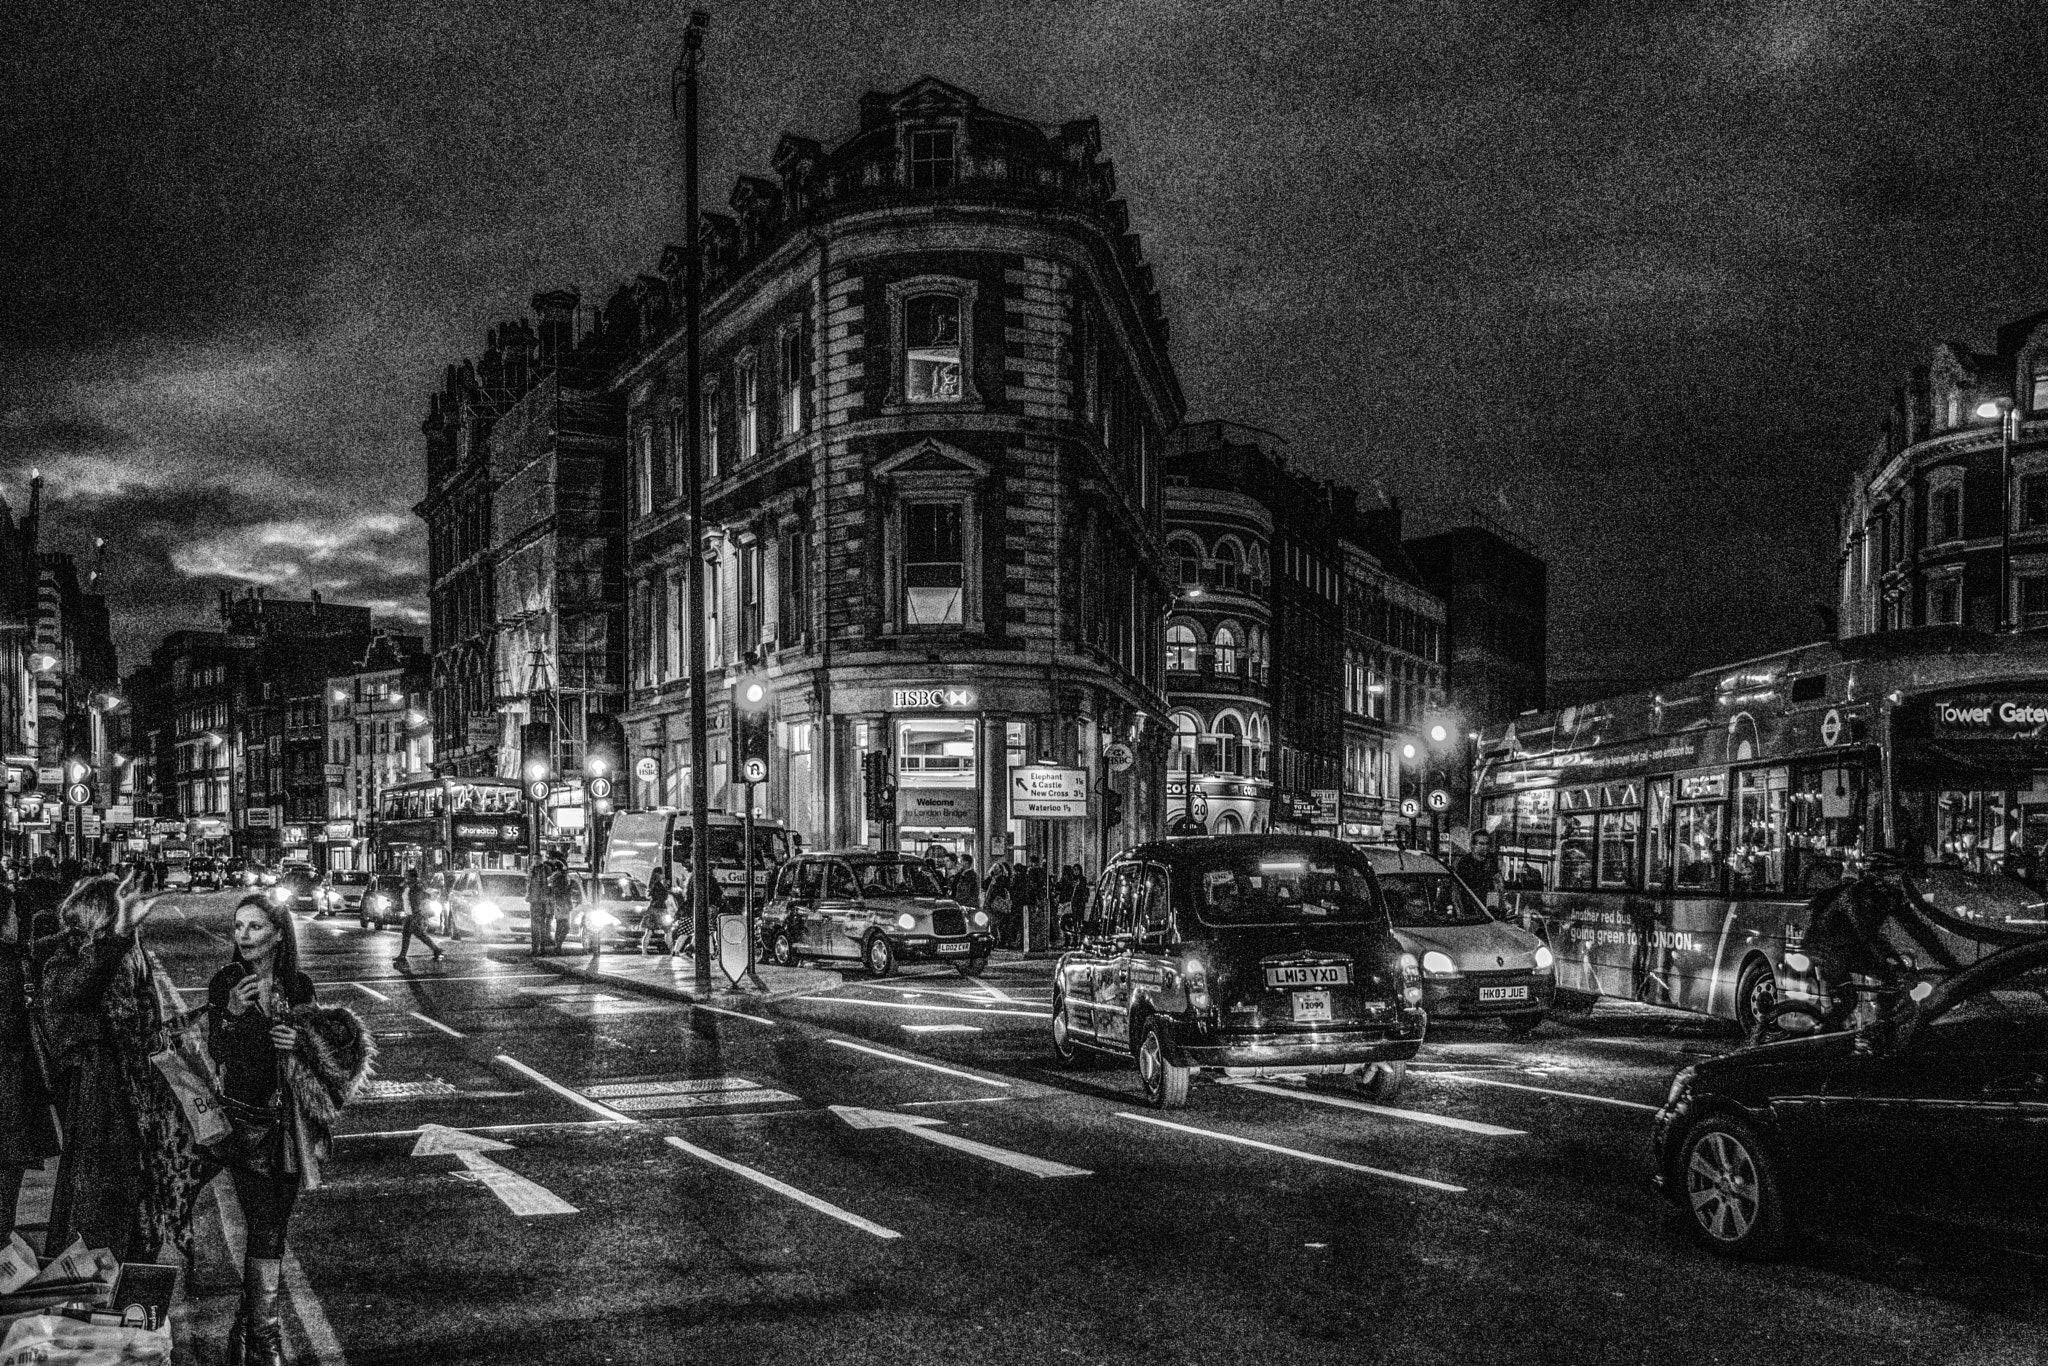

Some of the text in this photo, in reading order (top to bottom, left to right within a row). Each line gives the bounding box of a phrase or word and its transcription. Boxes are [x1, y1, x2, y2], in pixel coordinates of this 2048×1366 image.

[894, 690, 944, 707] HSBC
[1936, 703, 1992, 722] Tower
[1652, 750, 1663, 760] zero
[1663, 746, 1685, 758] emission
[1685, 744, 1695, 755] bus
[916, 798, 955, 806] Welcome
[1028, 803, 1061, 812] Waterloo
[943, 808, 968, 819] Bridge
[1194, 804, 1206, 815] 20
[461, 826, 519, 837] Shoreditch 35
[1570, 908, 1632, 925] Another red bus
[1570, 927, 1595, 943] going
[1597, 929, 1625, 946] green
[1645, 930, 1692, 951] LONDON
[1275, 968, 1339, 984] LM13 YXD
[1483, 987, 1525, 999] HK03 JUE
